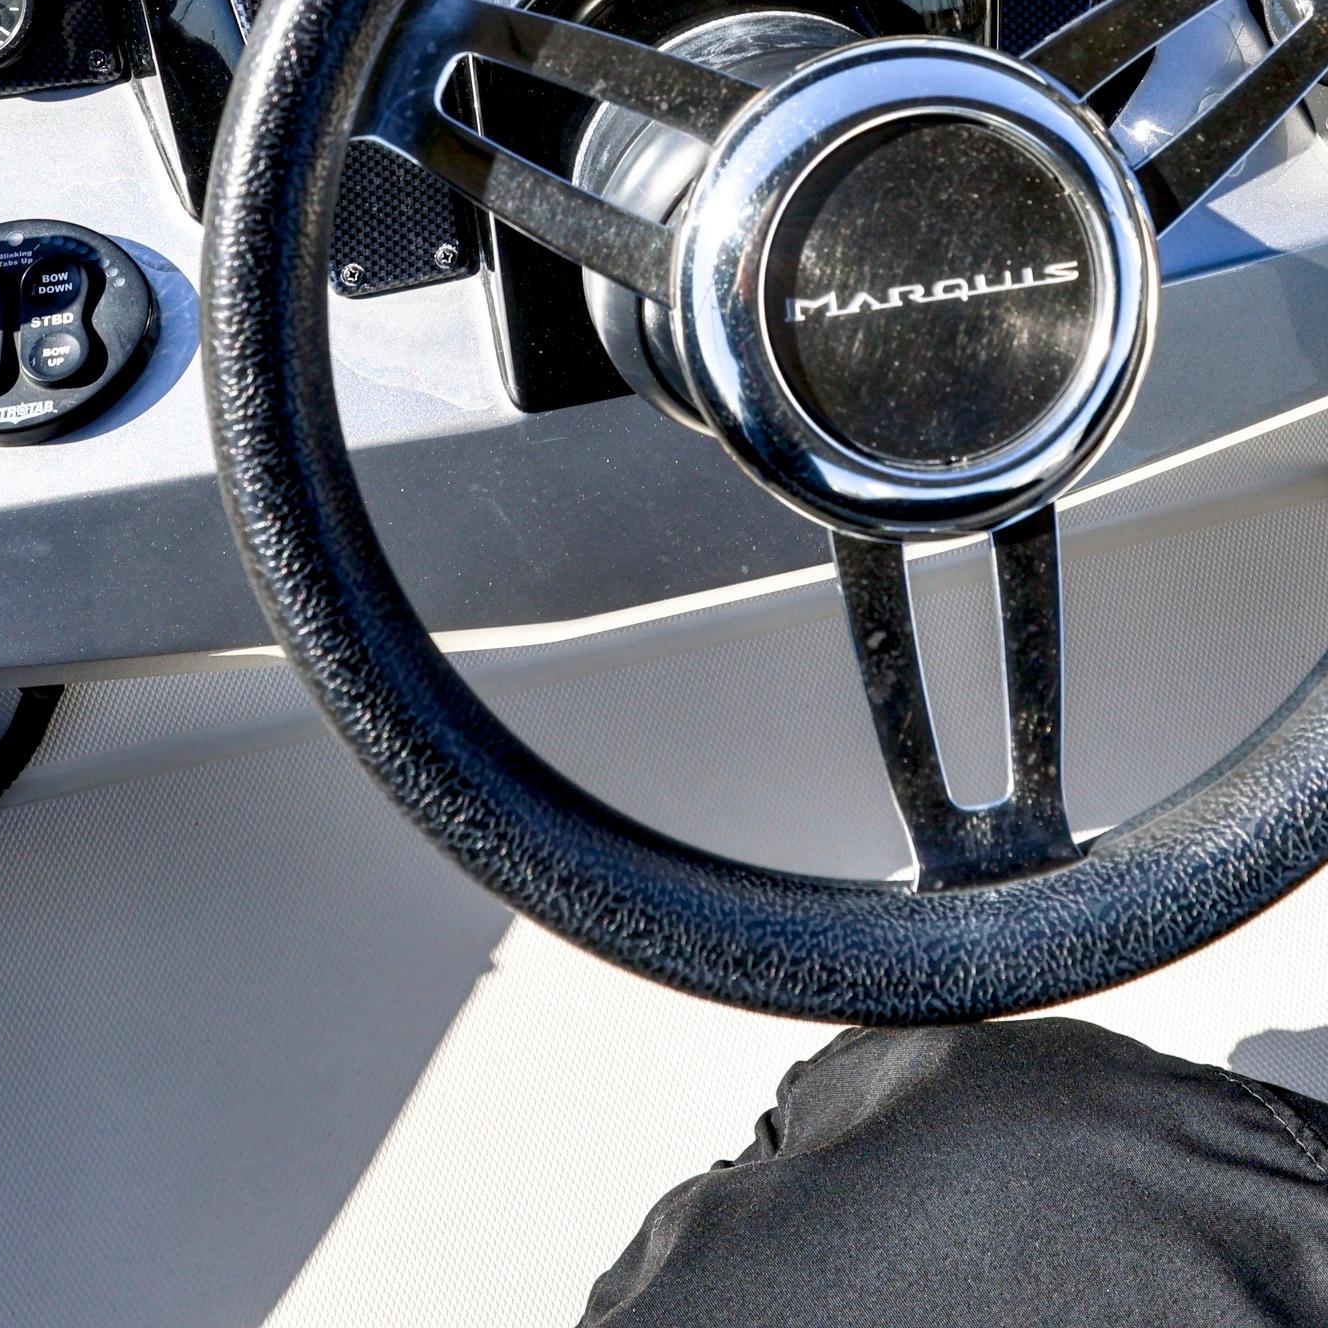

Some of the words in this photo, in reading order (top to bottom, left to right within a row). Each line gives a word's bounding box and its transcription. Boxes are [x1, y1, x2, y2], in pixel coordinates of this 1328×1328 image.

[20, 256, 33, 267] Up
[42, 272, 69, 283] BOW
[38, 282, 73, 294] DOWN
[785, 261, 1079, 323] MARQUIS
[30, 312, 74, 328] STBD
[42, 346, 70, 358] BOW
[48, 357, 65, 367] UP
